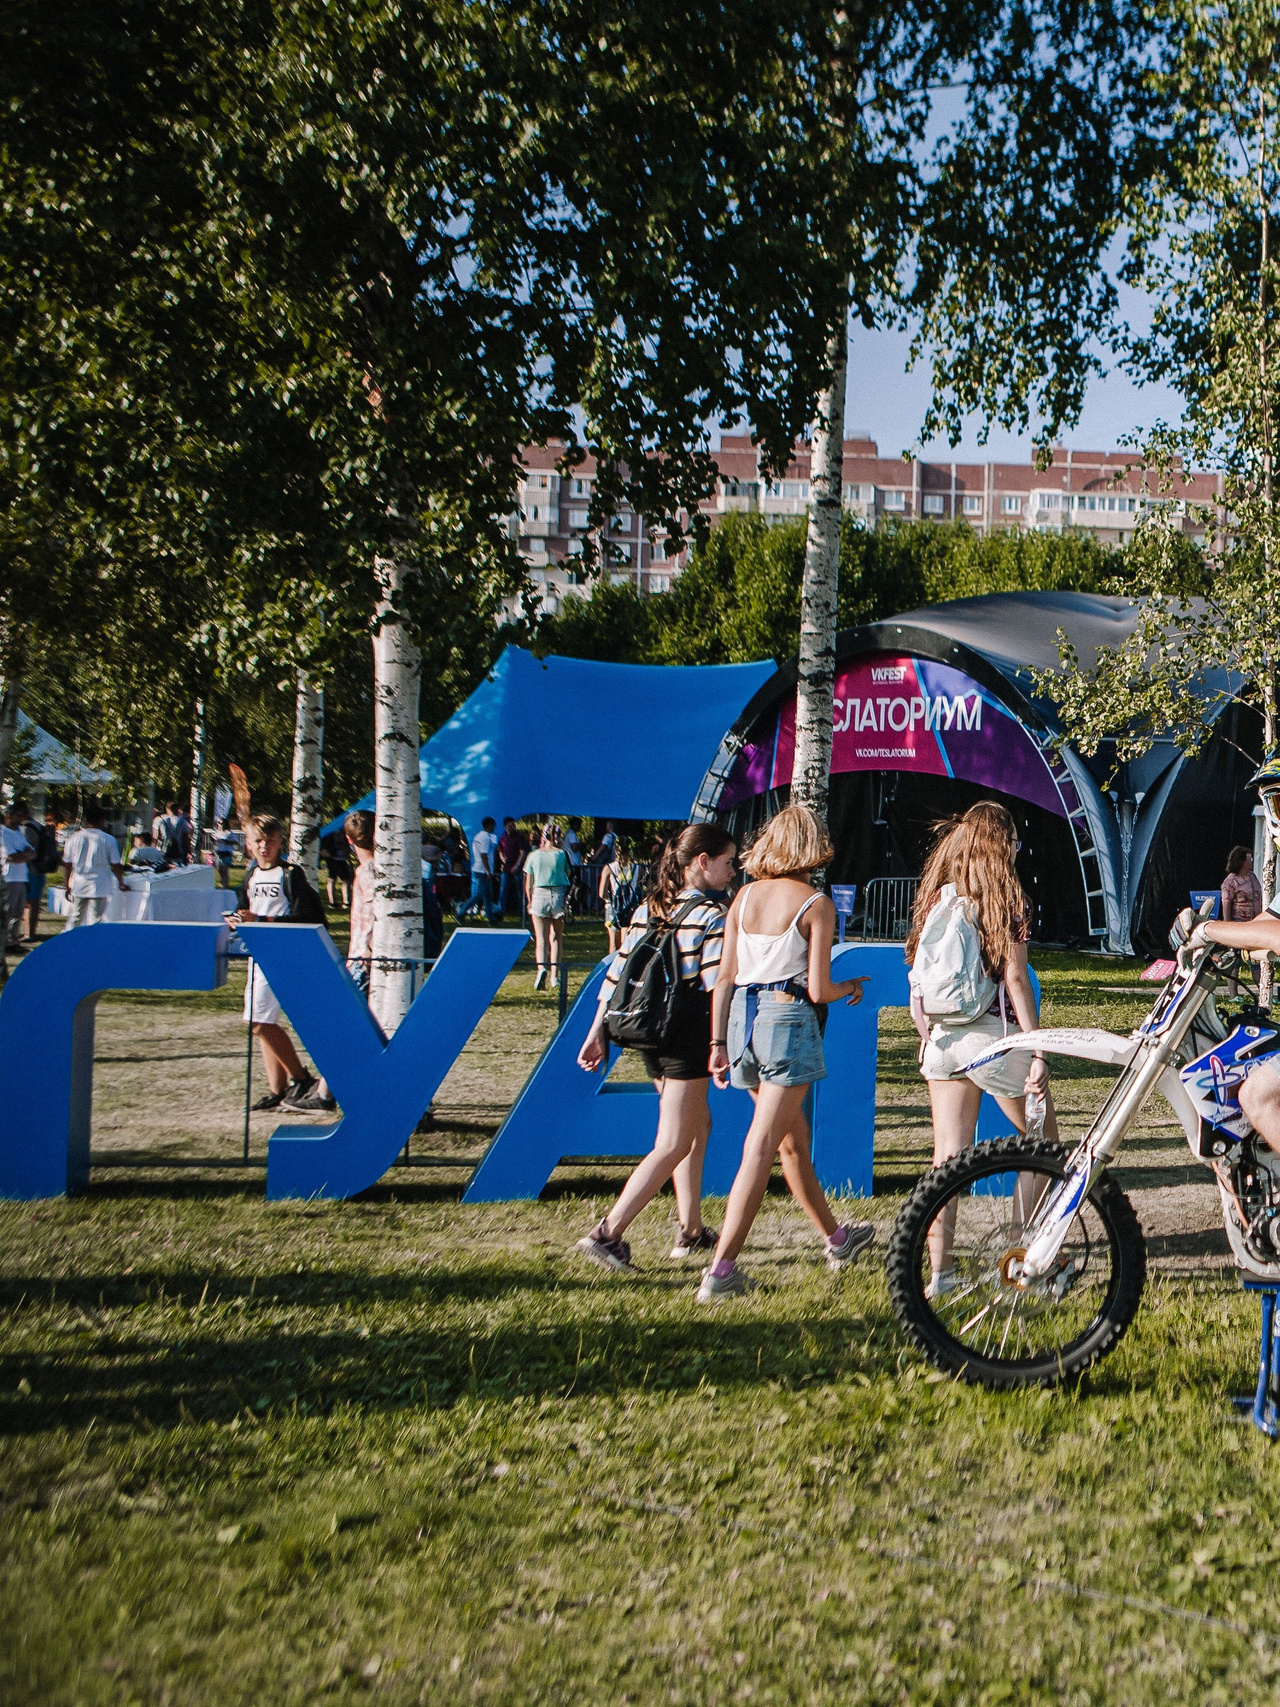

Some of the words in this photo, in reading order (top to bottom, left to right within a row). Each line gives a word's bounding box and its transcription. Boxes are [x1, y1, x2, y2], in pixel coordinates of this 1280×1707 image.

[871, 666, 907, 681] VKFEST
[833, 695, 983, 732] СЛАТОРИУМ
[250, 882, 280, 898] ANS
